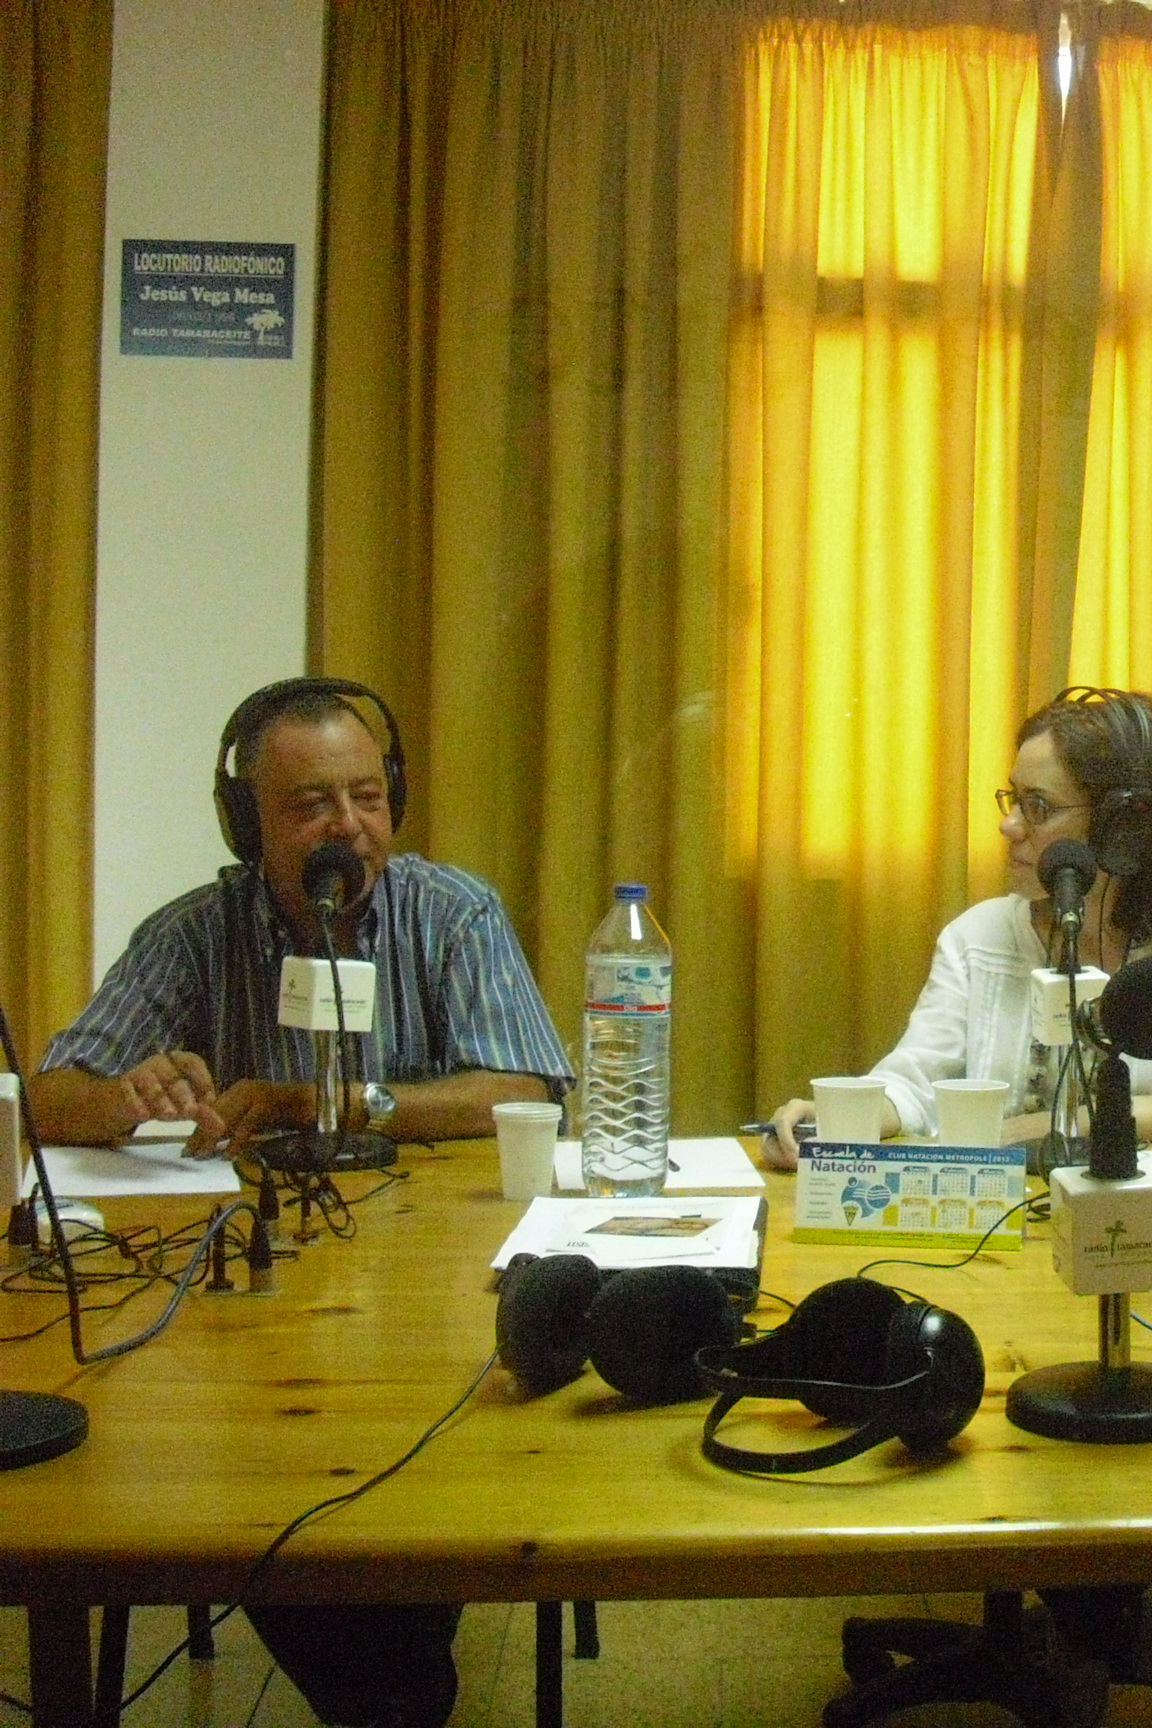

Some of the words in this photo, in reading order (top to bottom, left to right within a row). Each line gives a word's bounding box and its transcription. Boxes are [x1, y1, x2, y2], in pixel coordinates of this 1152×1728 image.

[134, 253, 201, 272] LOCUTORIO
[140, 285, 187, 301] Jesús
[190, 286, 230, 306] Vega
[234, 287, 275, 304] Mesa
[812, 1145, 857, 1159] Escuela
[860, 1149, 875, 1160] de
[888, 1152, 906, 1160] CLUB
[811, 1160, 876, 1174] Natación
